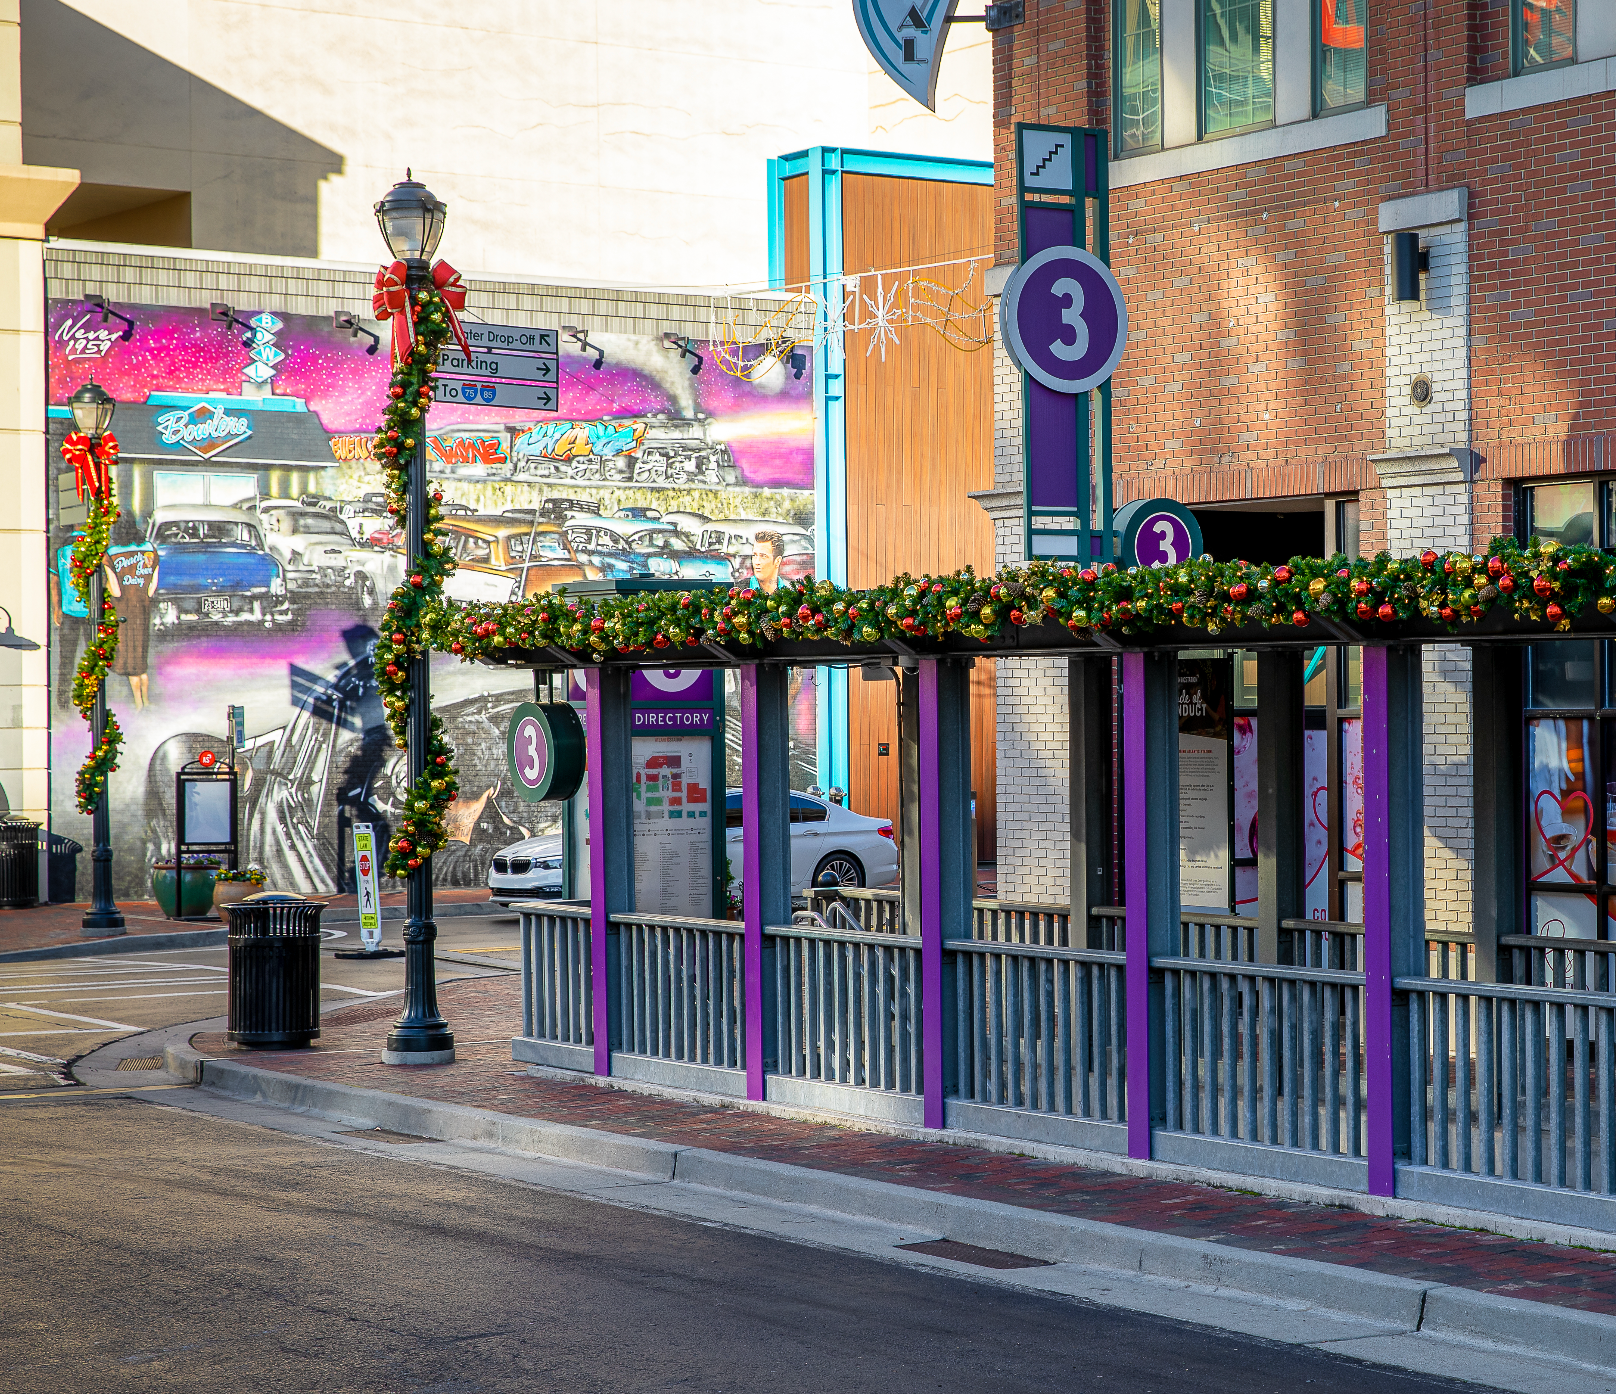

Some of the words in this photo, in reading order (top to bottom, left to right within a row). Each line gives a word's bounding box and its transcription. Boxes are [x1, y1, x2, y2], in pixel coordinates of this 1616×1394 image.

[55, 314, 123, 341] Never
[1048, 277, 1090, 361] 3
[65, 339, 112, 357] 1959
[487, 330, 536, 346] Drop-Off
[441, 353, 499, 375] Parking
[441, 383, 459, 398] To
[464, 389, 475, 397] 75
[483, 391, 493, 399] 85
[157, 404, 248, 444] Bowlero
[1151, 520, 1177, 569] 3
[1192, 689, 1203, 707] of
[635, 713, 710, 725] DIRECTORY
[523, 724, 540, 780] 3
[359, 861, 370, 870] STOP
